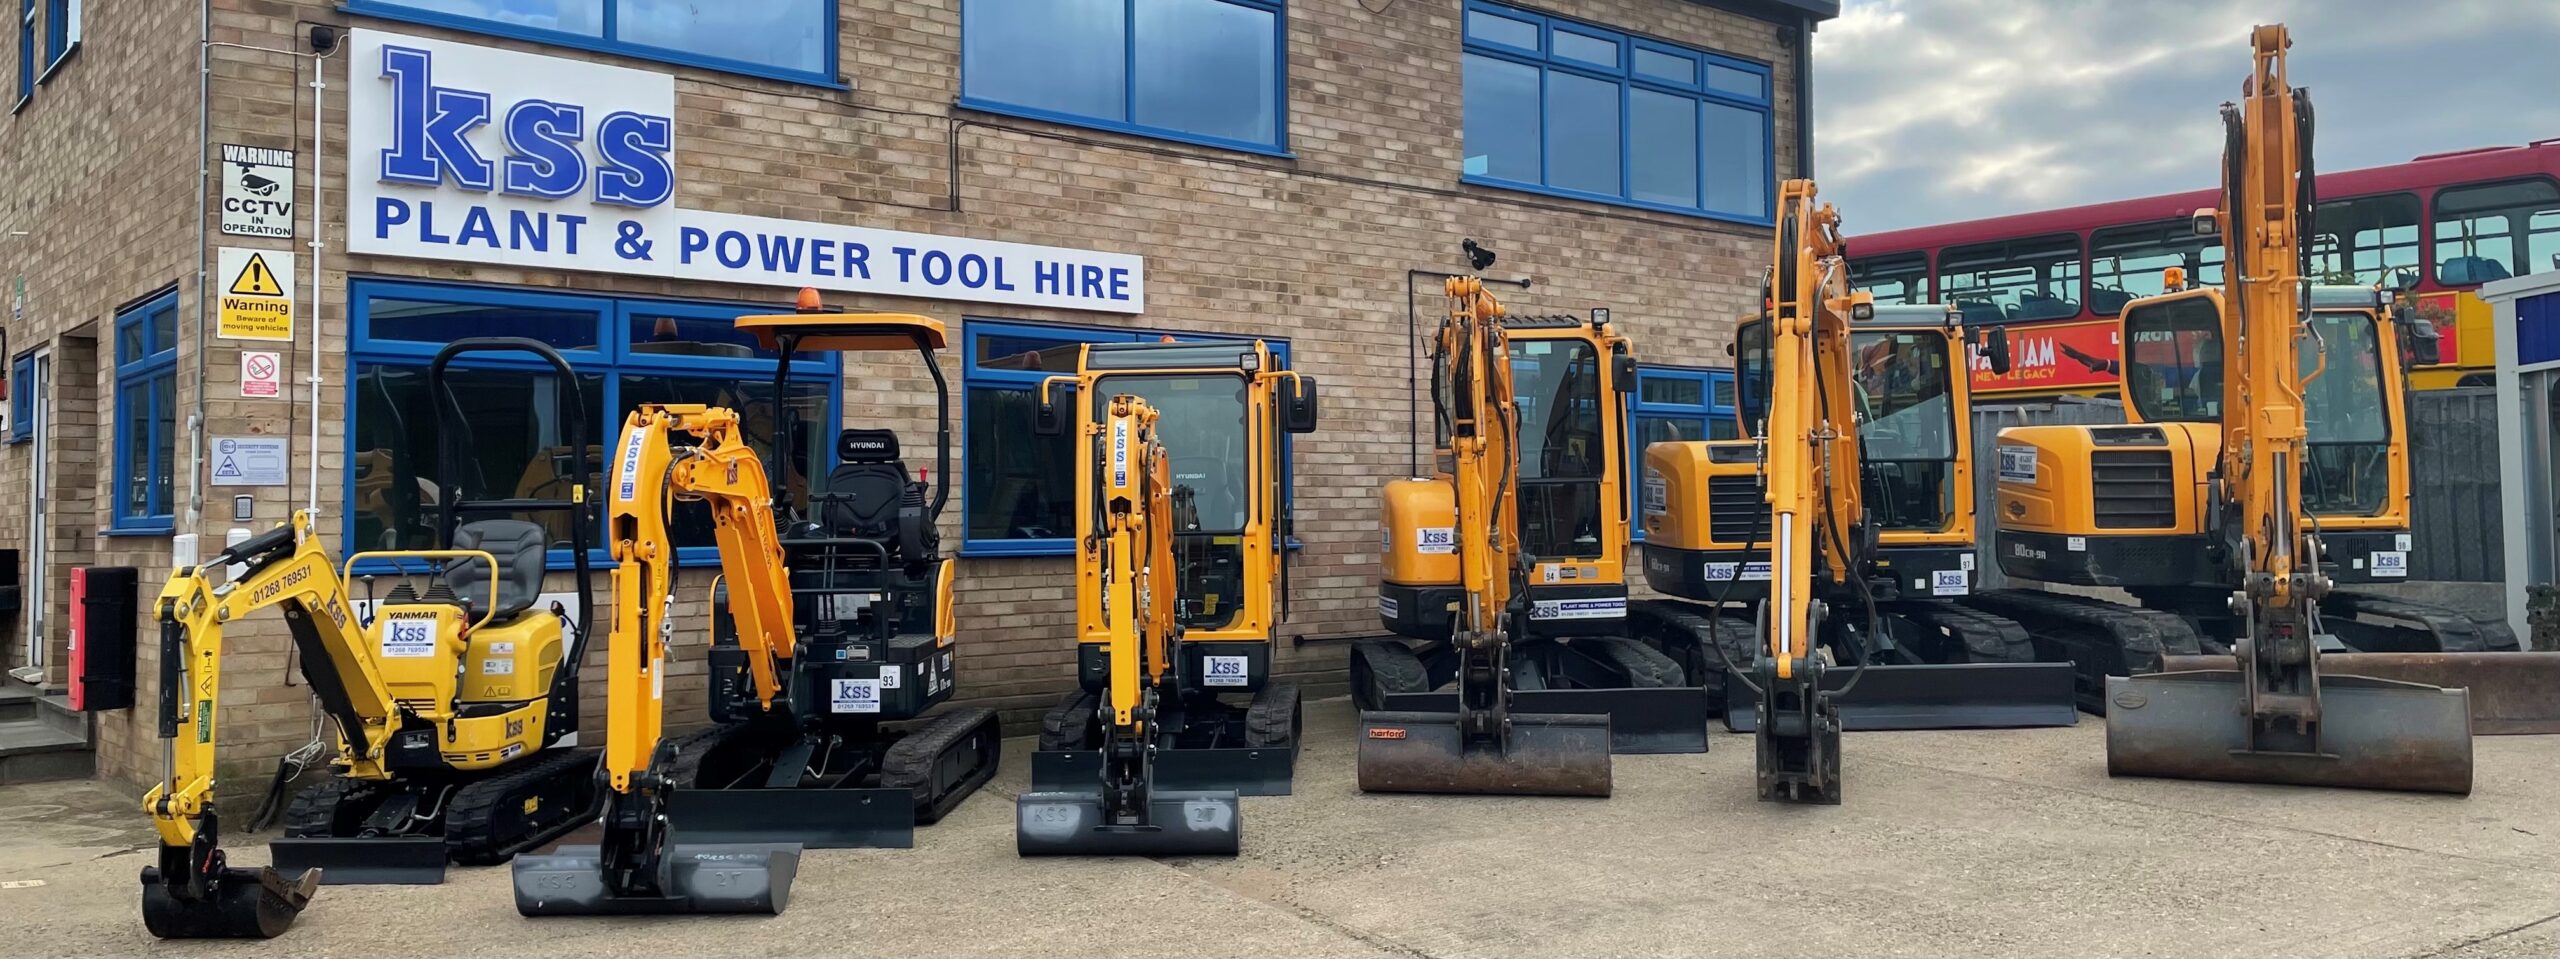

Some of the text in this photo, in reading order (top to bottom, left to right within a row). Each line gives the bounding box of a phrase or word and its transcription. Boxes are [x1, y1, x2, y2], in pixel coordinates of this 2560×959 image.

[380, 44, 674, 209] kss
[223, 145, 293, 167] WARNING
[224, 197, 291, 216] CCTV
[251, 216, 264, 225] IN
[223, 223, 291, 236] OPERATION
[376, 197, 1130, 301] PLANT & POWER TOOL HIRE
[224, 298, 288, 315] Warning
[236, 314, 266, 322] Beware
[223, 323, 288, 332] moving vehicles
[2007, 368, 2056, 380] LEGACY
[1423, 529, 1448, 543] kss
[2014, 543, 2047, 560] 80CR-9A
[1962, 560, 1971, 569] 97
[2376, 553, 2400, 567] kss
[1546, 572, 1555, 581] 94
[1706, 564, 1732, 579] kss
[1938, 572, 1962, 586] kss
[253, 564, 312, 604] 01268 769531
[391, 622, 426, 642] kss
[1211, 658, 1240, 674] kss
[883, 675, 894, 686] 93
[840, 681, 871, 699] kss
[1370, 730, 1405, 738] harford
[1034, 806, 1067, 822] KSS
[536, 874, 577, 890] KSS
